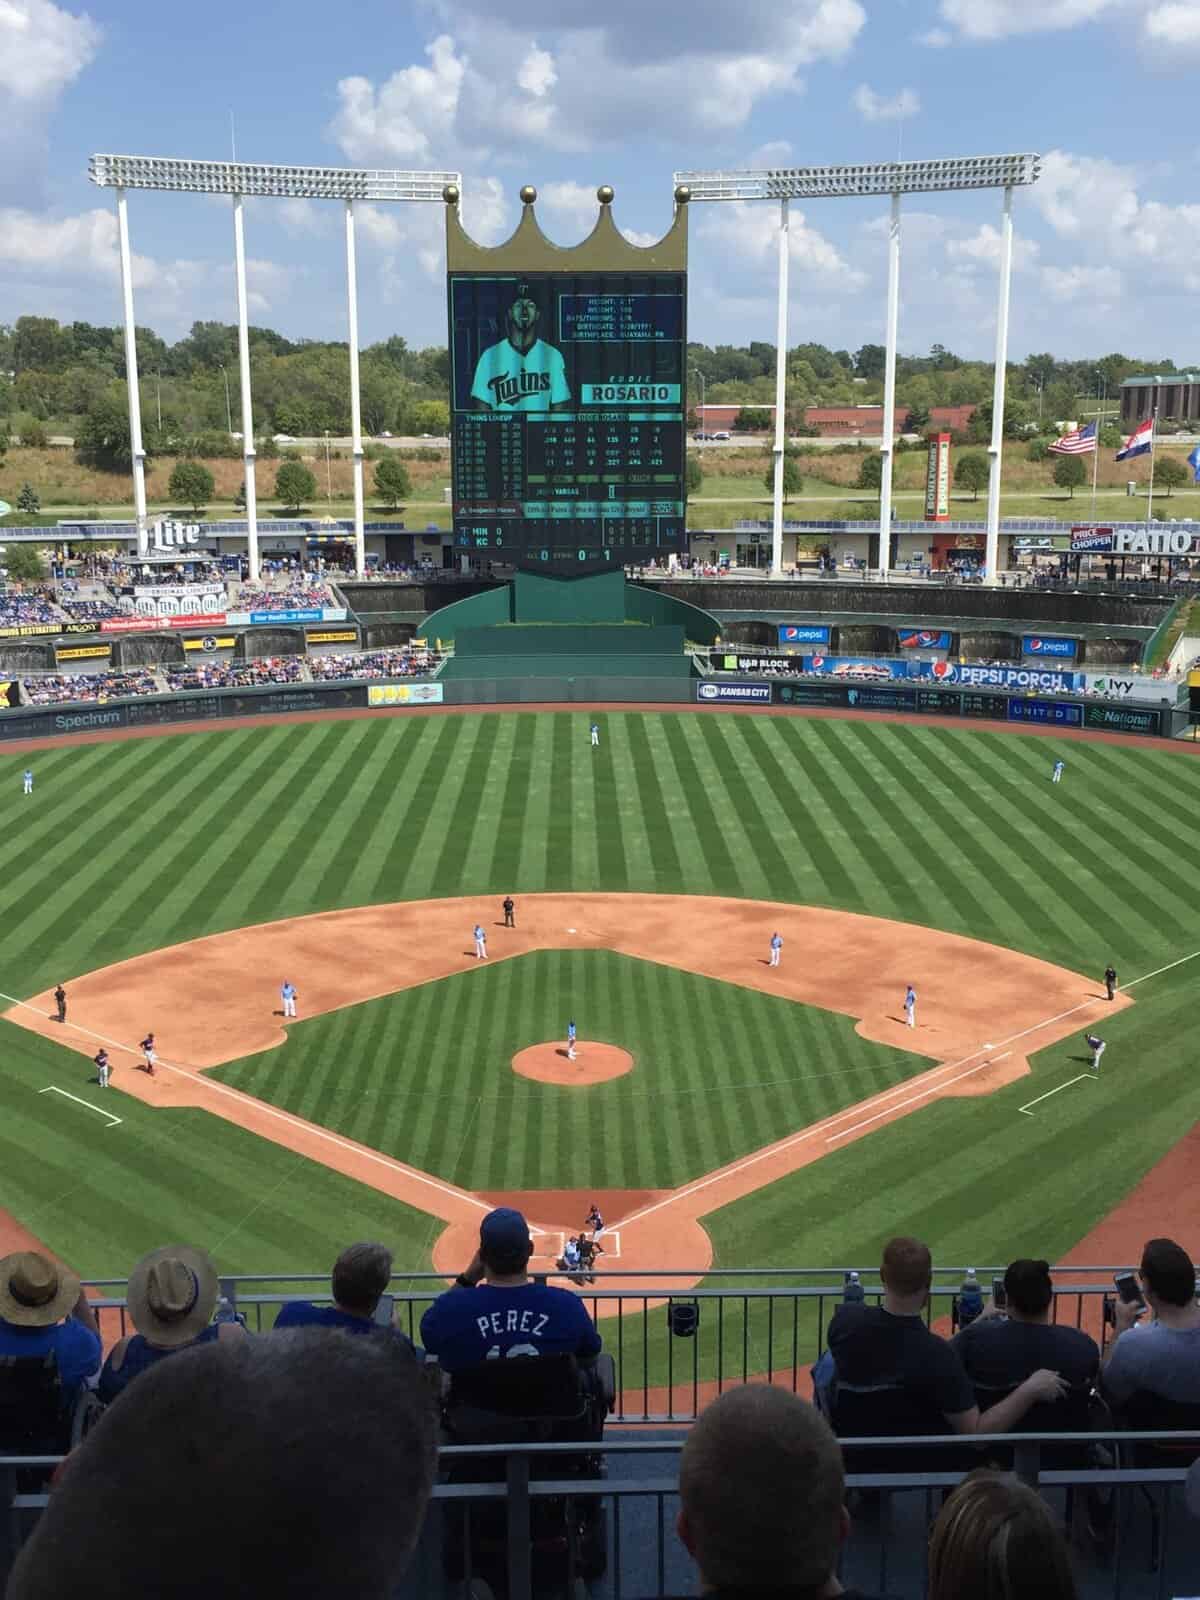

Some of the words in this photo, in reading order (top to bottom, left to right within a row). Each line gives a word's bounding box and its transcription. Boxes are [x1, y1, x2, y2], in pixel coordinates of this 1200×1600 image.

[488, 368, 550, 406] Twins
[592, 386, 669, 401] ROSARIO
[153, 520, 201, 552] Lite
[472, 527, 488, 535] MIN
[1073, 530, 1098, 539] PRICE
[476, 538, 488, 546] KC
[1072, 536, 1112, 550] CHOPPER
[1117, 529, 1192, 553] PATIO
[541, 550, 549, 561] 0
[578, 550, 586, 561] 0
[604, 550, 611, 561] 1
[798, 630, 823, 639] pepsi
[1043, 642, 1068, 651] pepsi
[759, 659, 789, 668] BLOCK
[960, 667, 1006, 686] PEPSI
[1007, 669, 1063, 688] PORCH
[720, 687, 750, 696] KANSAS
[751, 688, 768, 697] CITY
[1110, 679, 1133, 693] Ivy
[1014, 706, 1063, 718] UNITED
[1104, 711, 1152, 725] National
[56, 711, 120, 730] Spectrum
[476, 1310, 549, 1338] PEREZ
